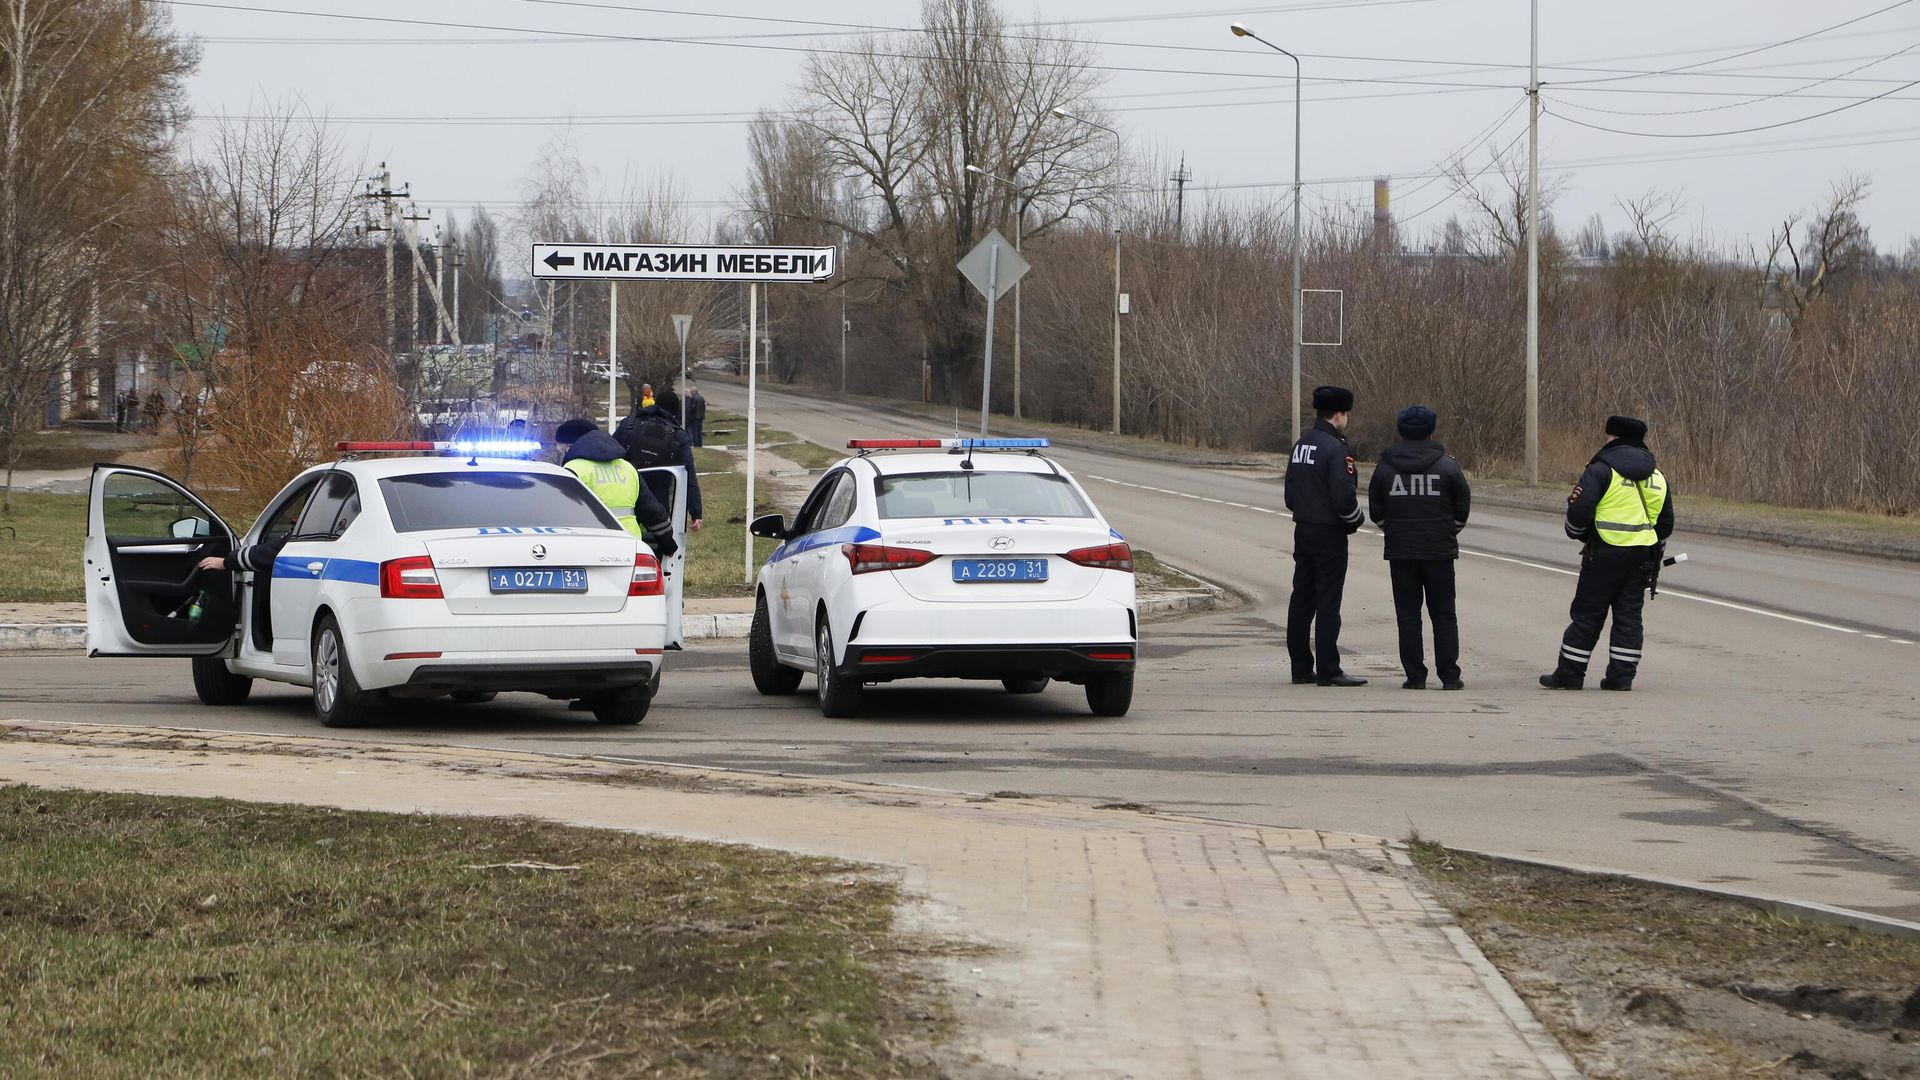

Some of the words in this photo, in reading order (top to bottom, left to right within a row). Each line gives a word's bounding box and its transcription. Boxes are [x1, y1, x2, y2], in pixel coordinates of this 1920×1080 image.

[583, 252, 708, 273] МАГАЗИН
[717, 253, 827, 274] МЕБЕЛИ
[1292, 444, 1317, 465] ДПС
[593, 464, 627, 484] ДПС
[1389, 474, 1441, 496] ДПС
[943, 518, 1051, 526] ДПС
[514, 571, 554, 587] 0277
[563, 570, 580, 582] 31
[977, 563, 1017, 578] 2289
[1027, 562, 1042, 573] 31
